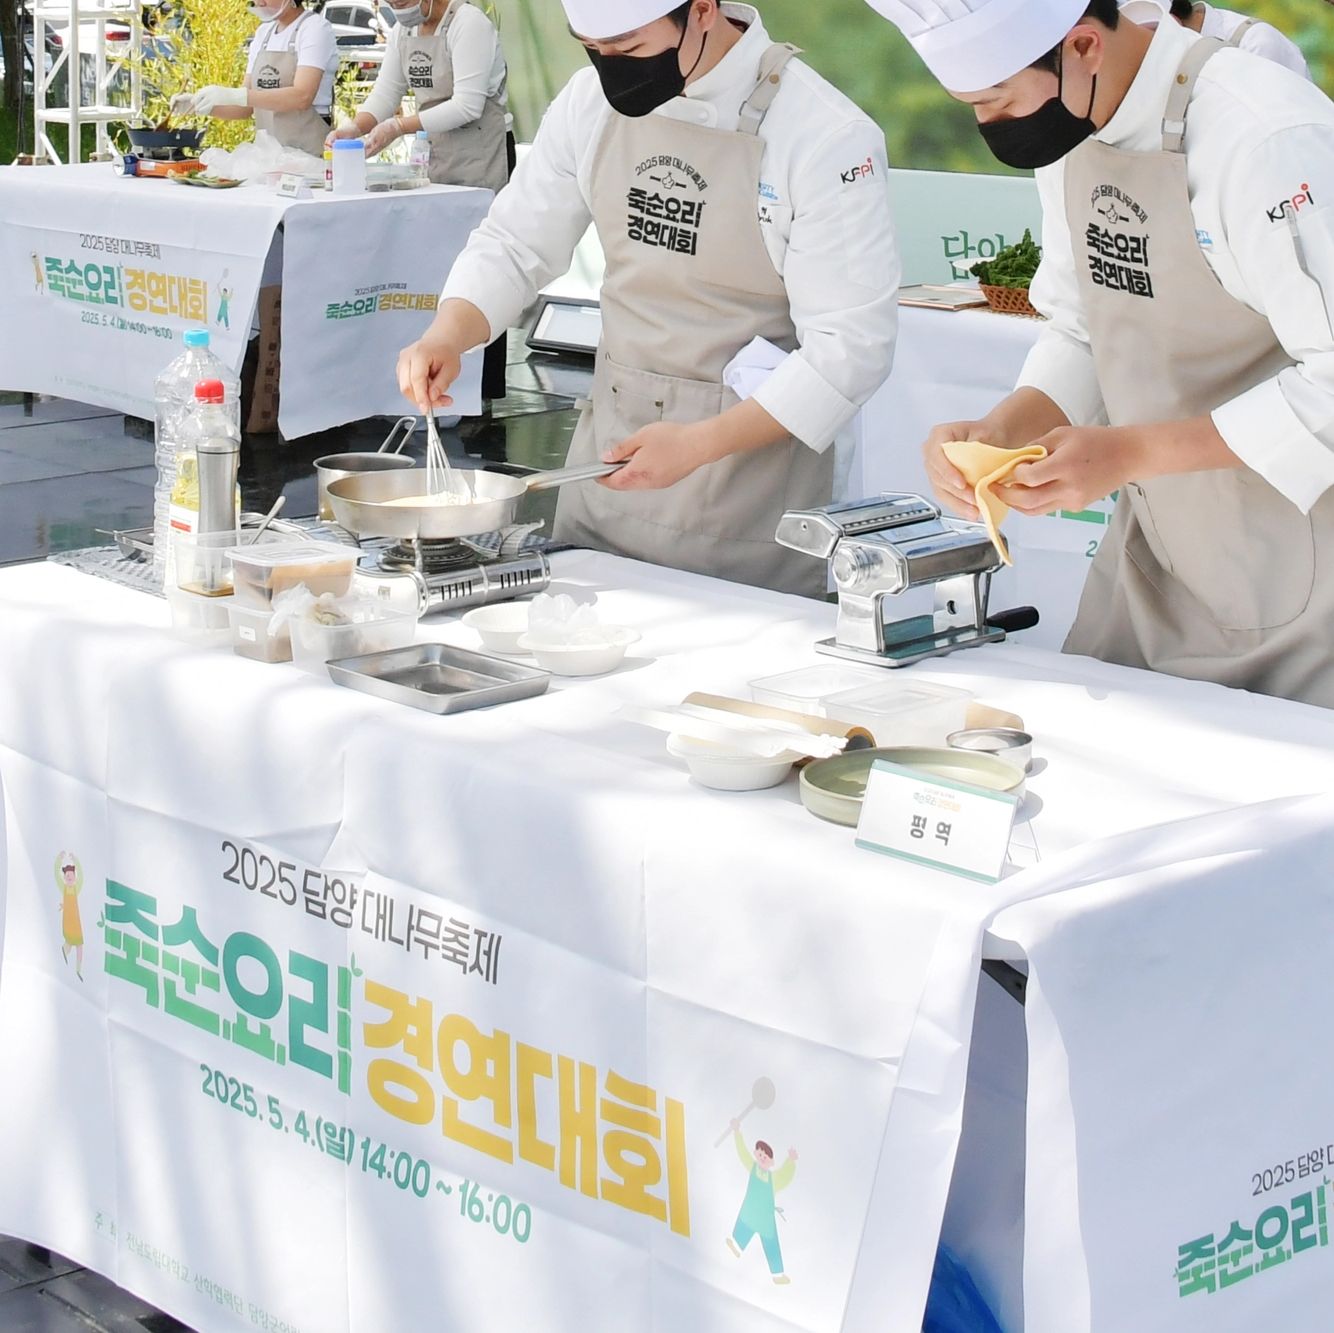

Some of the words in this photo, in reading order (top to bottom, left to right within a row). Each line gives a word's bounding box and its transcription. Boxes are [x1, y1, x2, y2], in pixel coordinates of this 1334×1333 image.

[635, 156, 659, 176] 2025
[628, 187, 705, 228] 죽순요리
[78, 233, 104, 252] 2025
[627, 213, 699, 256] 경연대회
[1086, 222, 1149, 267] 죽순요리
[45, 254, 125, 308] 죽순요리
[124, 267, 208, 325] 경연대회
[1087, 254, 1154, 299] 경연대회
[326, 295, 378, 319] 죽순요리
[378, 293, 440, 312] 경연대회
[219, 839, 298, 908] 2025
[300, 867, 359, 932] 담양
[360, 887, 504, 986] 대나무축제
[102, 876, 355, 1097] 죽순요리
[362, 977, 693, 1238] 경연대회
[360, 1135, 431, 1199] 14:00
[459, 1177, 533, 1244] 16:00
[1250, 1158, 1297, 1198] 2025
[1297, 1145, 1325, 1181] 담양
[1174, 1176, 1331, 1299] 죽순요리
